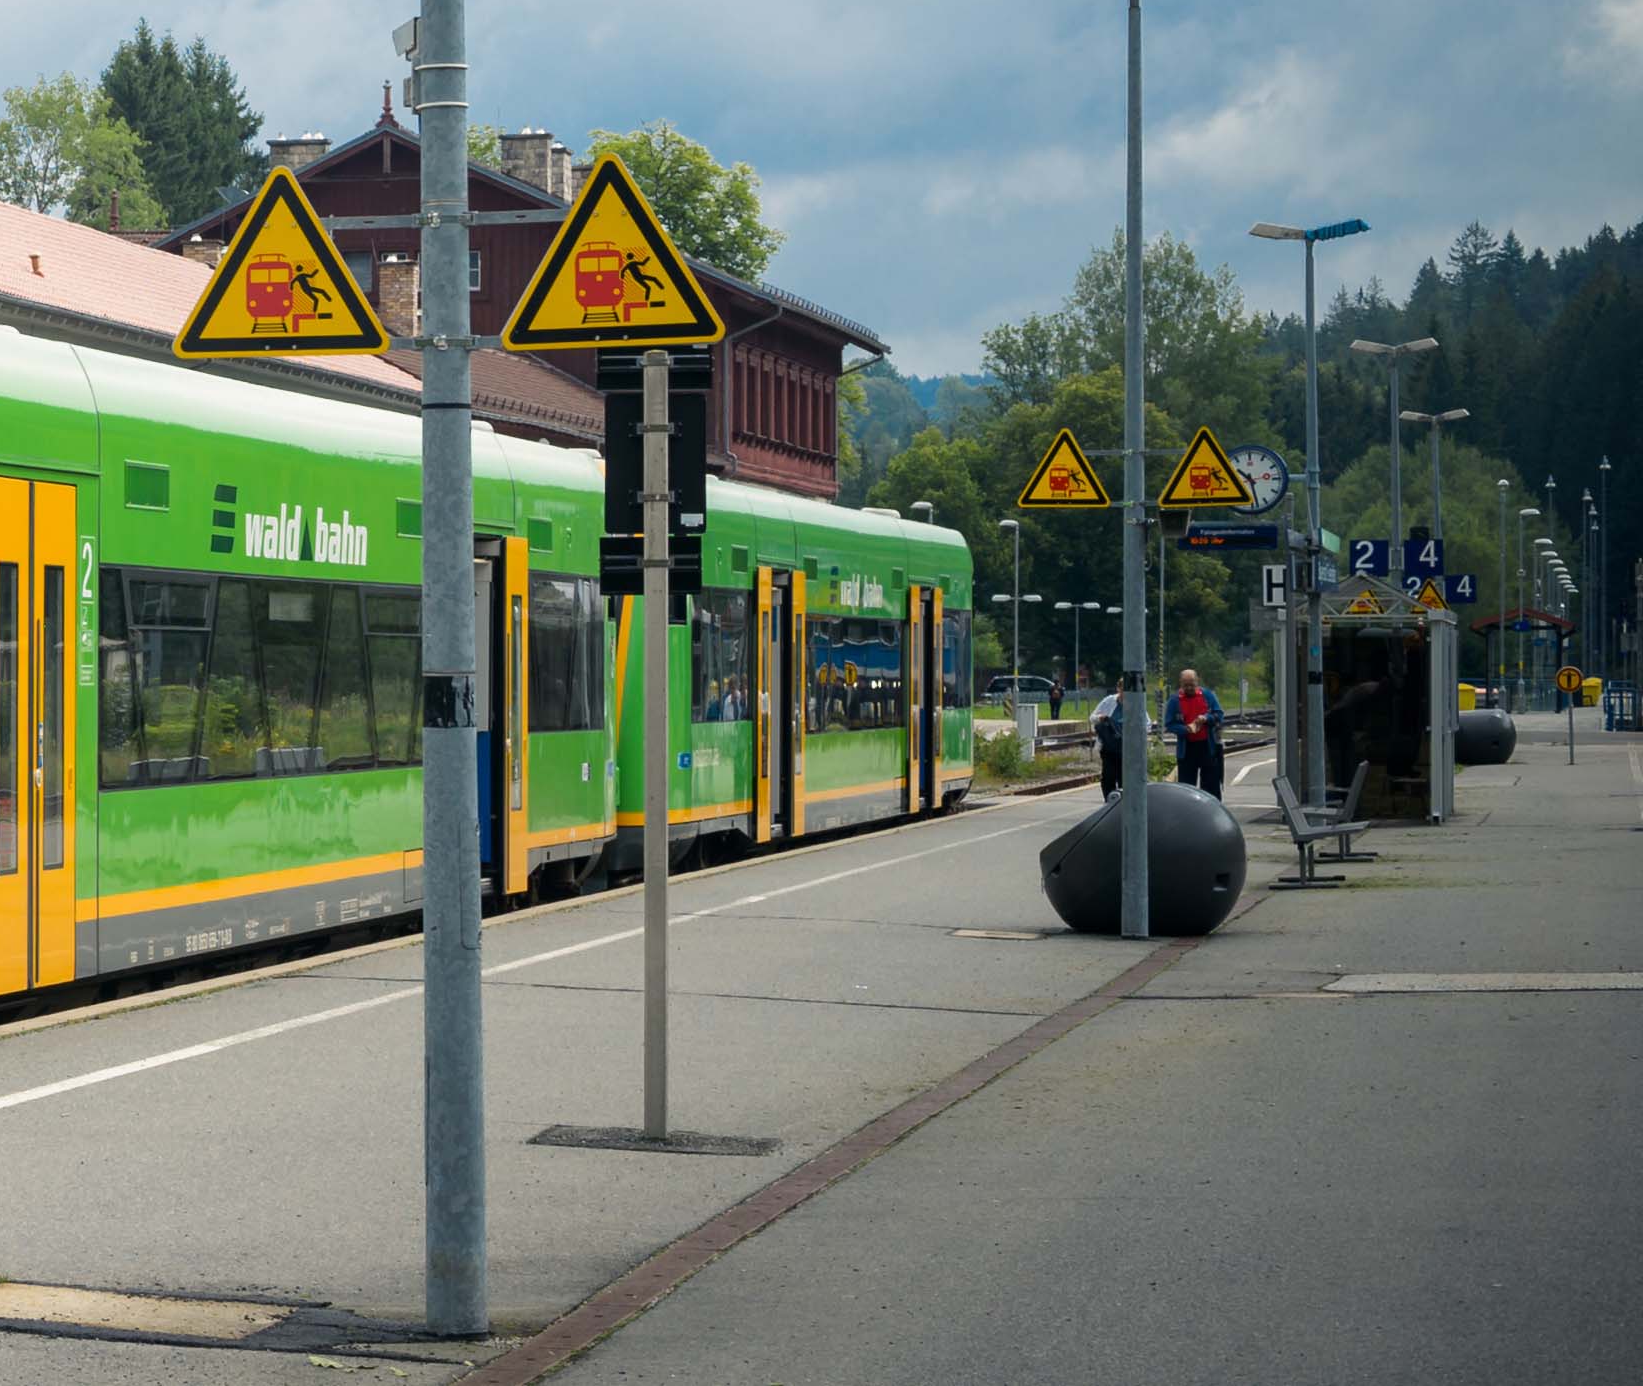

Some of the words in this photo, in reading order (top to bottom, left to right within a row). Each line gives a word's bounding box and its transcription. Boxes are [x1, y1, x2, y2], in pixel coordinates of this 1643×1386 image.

[1355, 540, 1374, 569] 2
[1419, 540, 1438, 568] 4
[82, 542, 93, 598] 2
[1266, 568, 1287, 604] H
[1406, 577, 1421, 598] 2
[1457, 575, 1472, 597] 4
